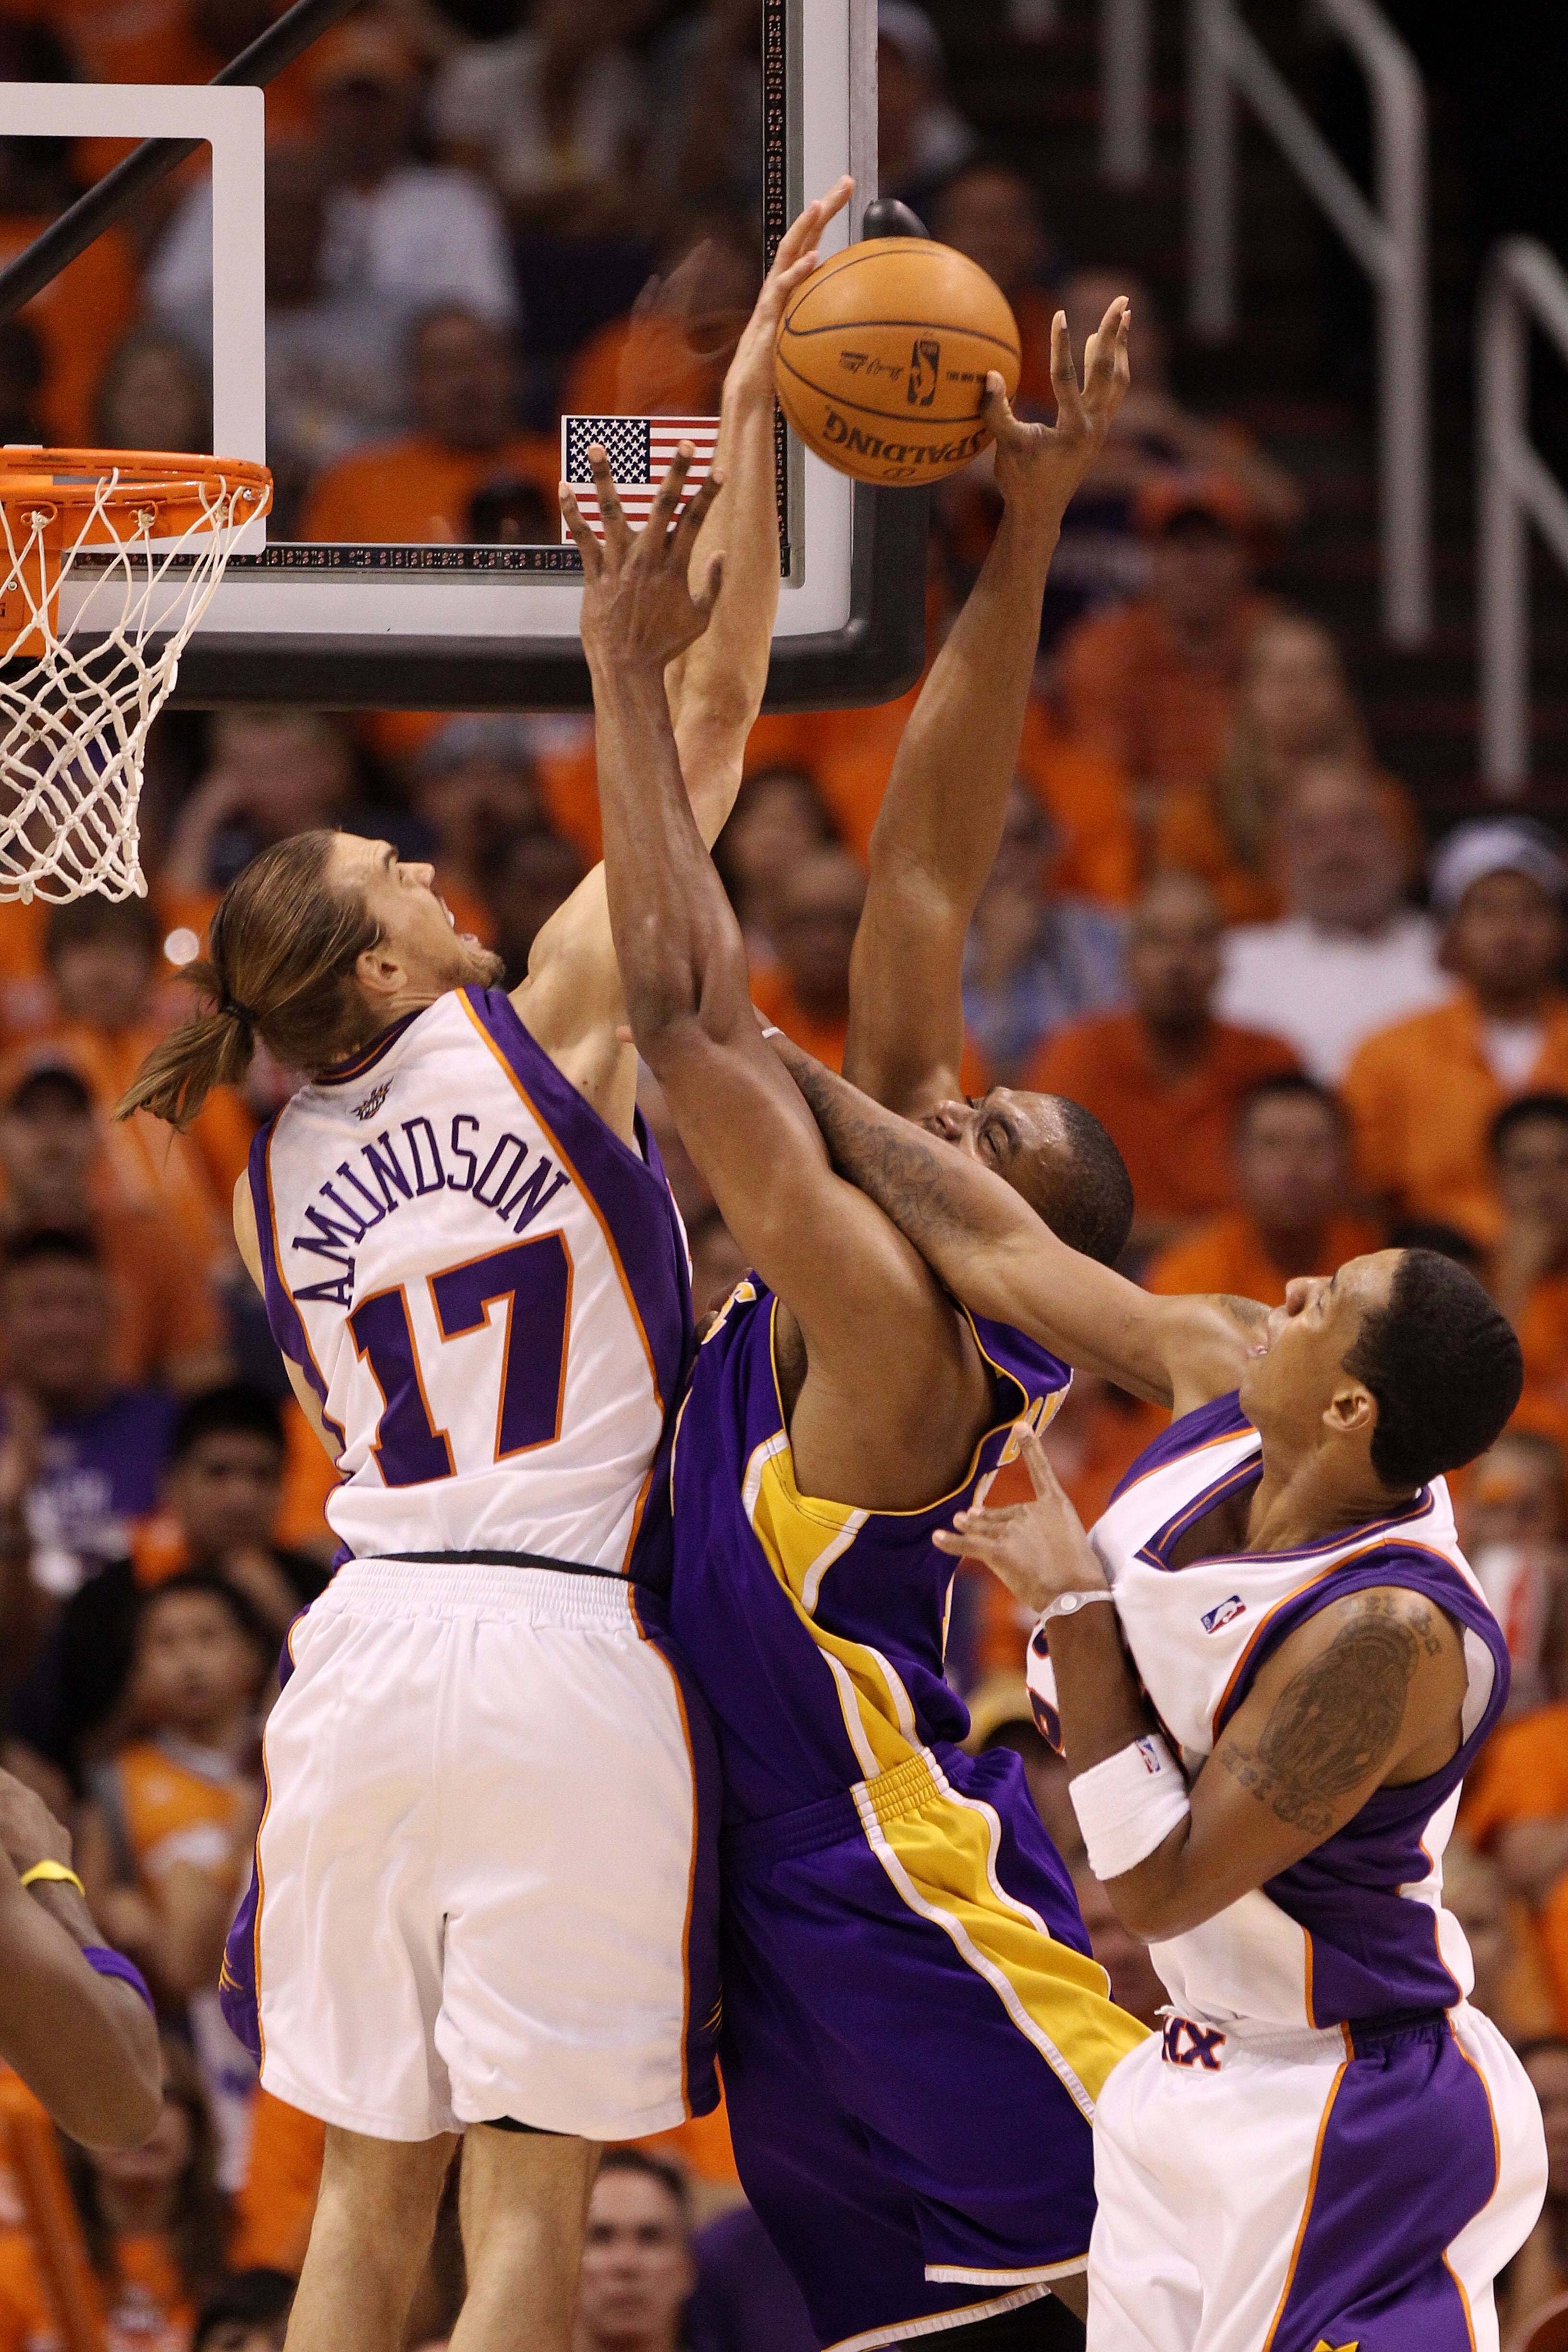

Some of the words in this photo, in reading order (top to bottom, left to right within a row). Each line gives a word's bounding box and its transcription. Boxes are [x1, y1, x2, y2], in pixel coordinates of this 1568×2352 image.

[822, 410, 986, 465] SPALDING
[292, 1115, 571, 1310] AMUNDSON
[346, 1228, 574, 1488] 17
